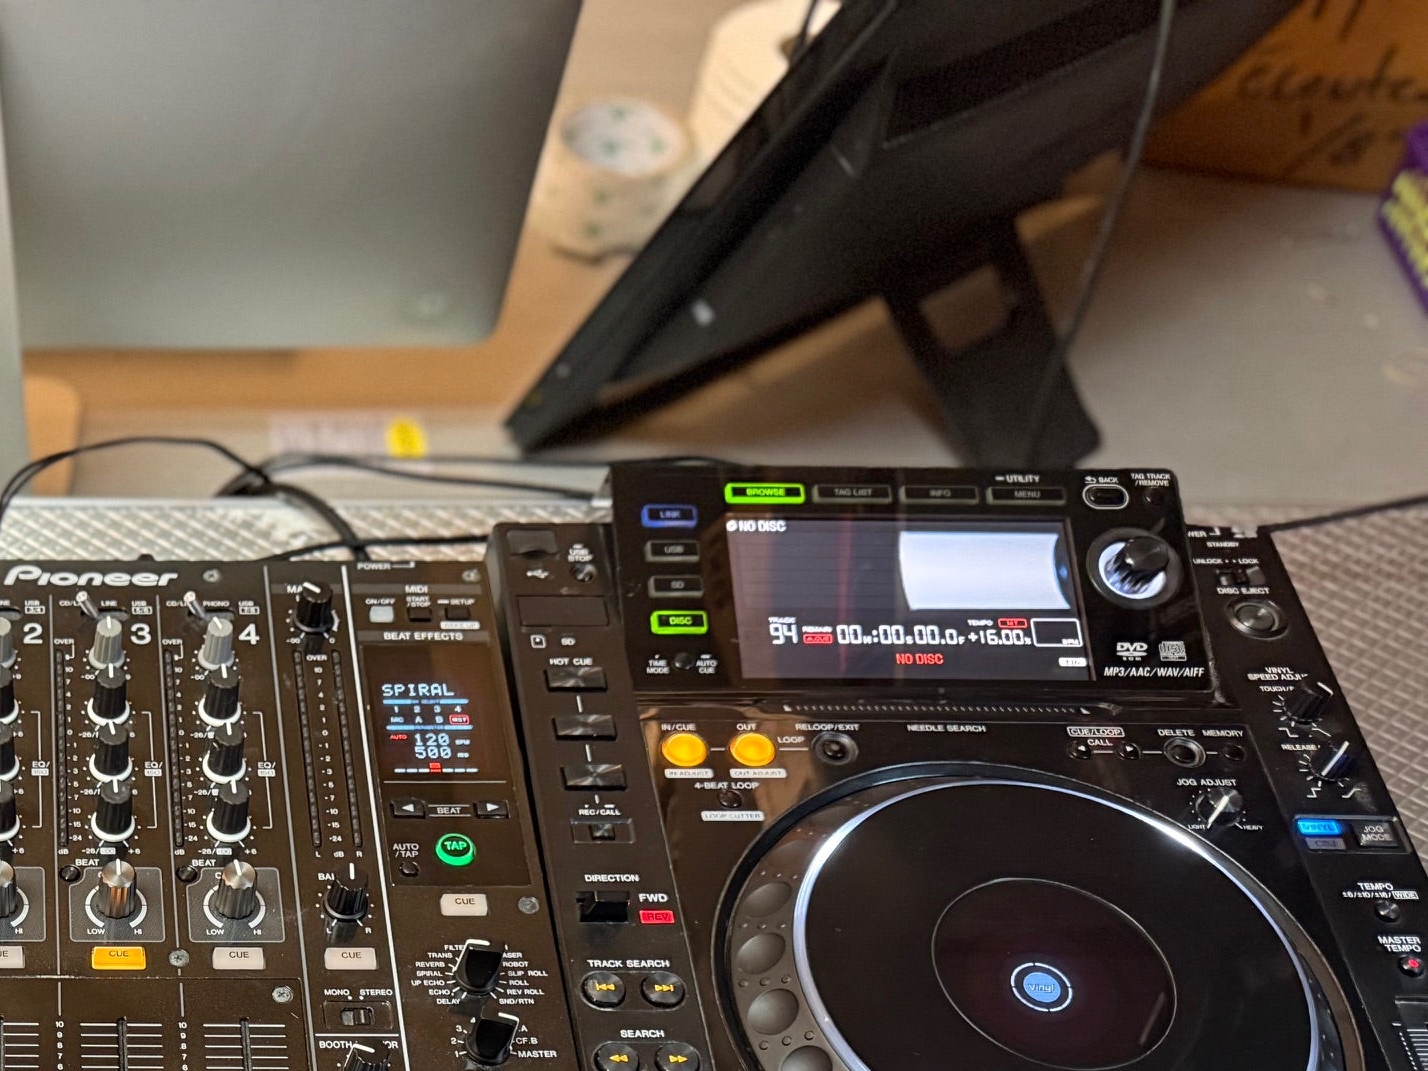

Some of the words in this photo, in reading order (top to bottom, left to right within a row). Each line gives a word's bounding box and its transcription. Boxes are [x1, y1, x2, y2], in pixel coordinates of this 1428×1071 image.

[1006, 475, 1040, 483] UTILITY
[747, 488, 785, 496] BROWSE
[739, 521, 756, 531] NO
[758, 521, 786, 532] DISC
[3, 565, 178, 586] Pioneer
[23, 623, 43, 644] 2
[131, 624, 151, 644] 3
[239, 624, 260, 645] 4
[384, 632, 411, 640] BEAT
[414, 632, 463, 640] EFFECTS
[770, 624, 798, 644] 94
[1117, 642, 1147, 652] DVD
[896, 654, 912, 664] NO
[916, 654, 944, 664] DISC
[1104, 667, 1204, 677] MP3/AAC/WAV/AIFF
[382, 683, 455, 697] SPIRAL
[415, 733, 449, 745] 120
[415, 746, 451, 758] 500
[444, 842, 466, 850] TAP
[584, 874, 639, 882] DIRECTION
[639, 894, 668, 902] FWD
[647, 912, 669, 920] REV
[1378, 936, 1421, 944] MASTER
[1384, 944, 1421, 952] TEMPO
[587, 960, 622, 968] TRACK
[627, 960, 670, 968] SEARCH
[1028, 984, 1054, 993] Vinyl
[620, 1030, 664, 1038] SEARCH
